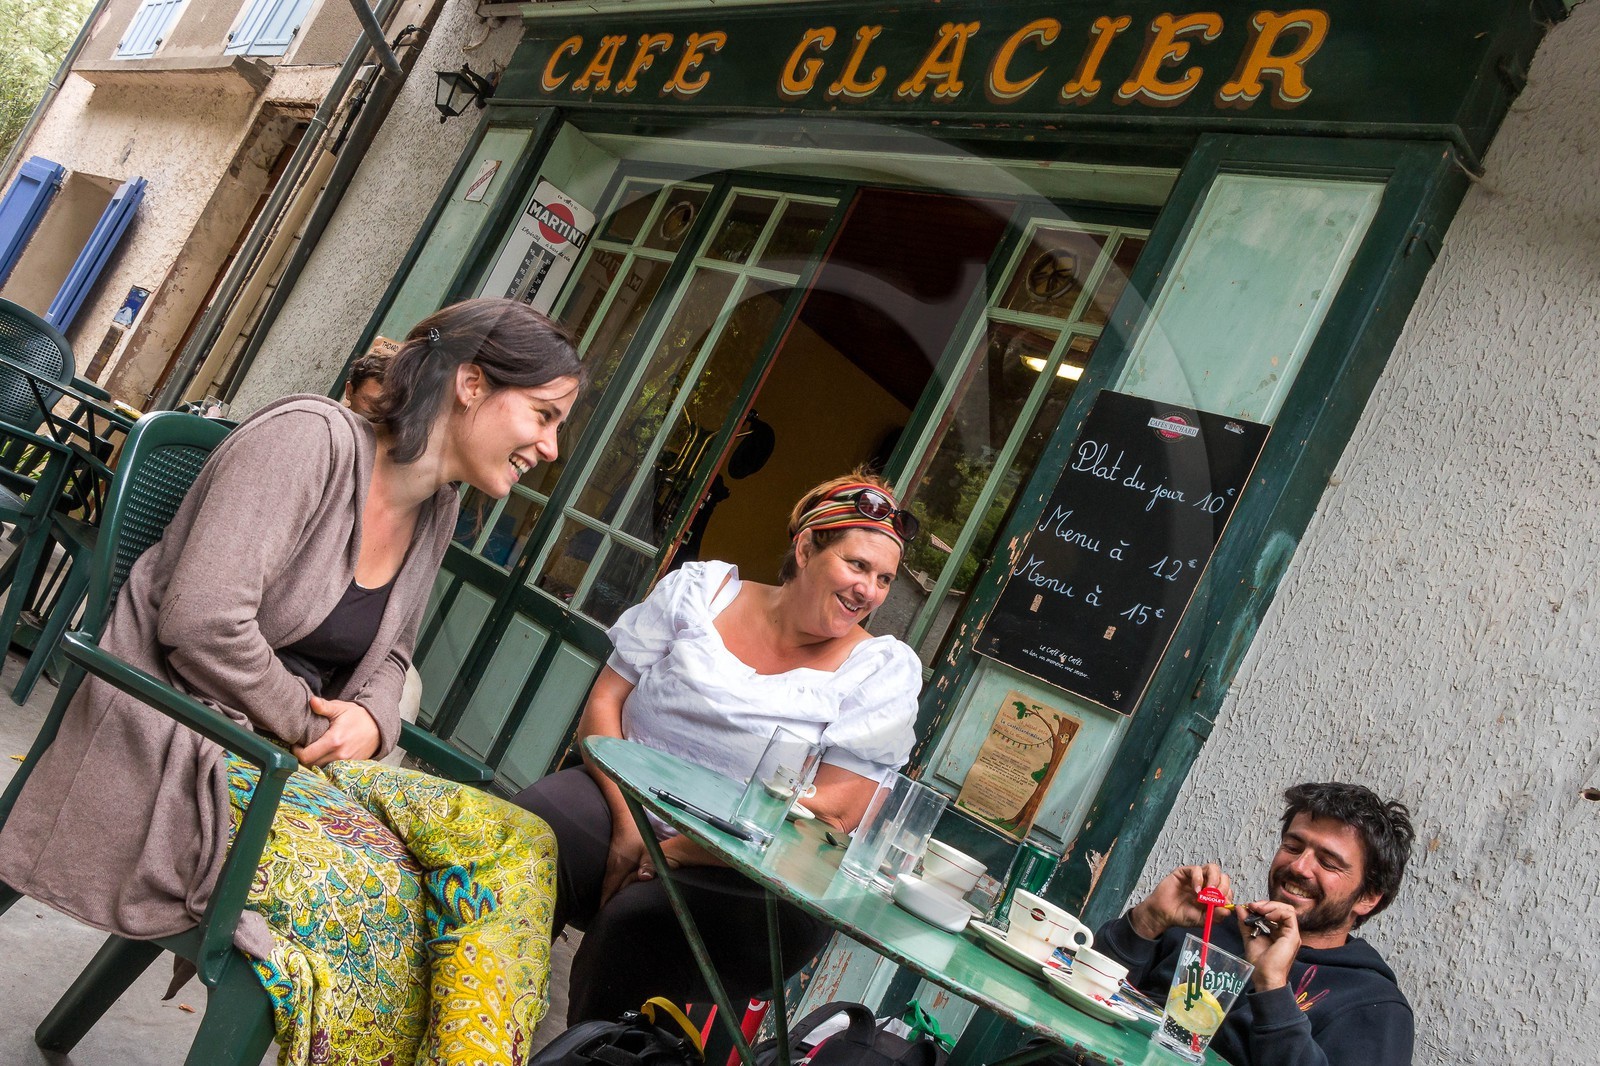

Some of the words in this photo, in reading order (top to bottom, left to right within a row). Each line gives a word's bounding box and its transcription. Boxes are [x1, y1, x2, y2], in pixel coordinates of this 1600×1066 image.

[541, 31, 727, 98] CAFE
[779, 9, 1331, 108] GLACIER
[529, 201, 586, 247] MARTINI
[1168, 423, 1197, 436] RICHARD
[1072, 440, 1124, 481] Plat
[1123, 465, 1146, 491] du
[1145, 477, 1185, 511] jour
[1038, 504, 1100, 552] Menu
[1109, 540, 1130, 561] à
[1013, 553, 1075, 597] Menu
[1085, 584, 1102, 606] à
[1199, 894, 1225, 904] FRIGOLET
